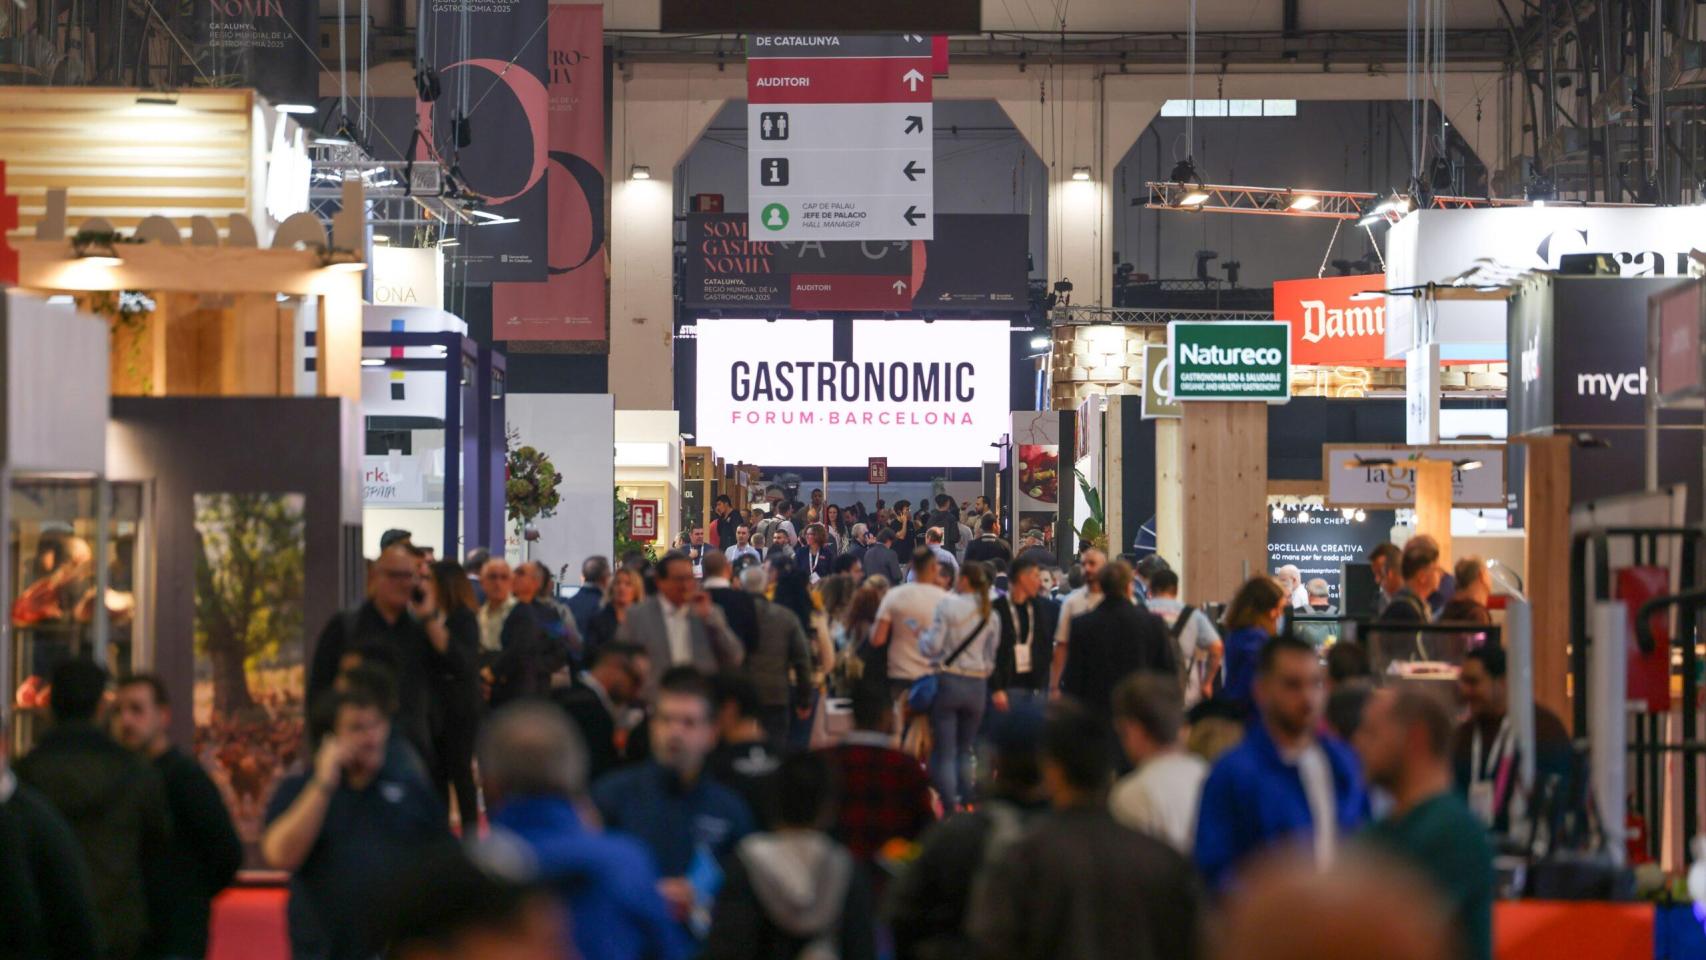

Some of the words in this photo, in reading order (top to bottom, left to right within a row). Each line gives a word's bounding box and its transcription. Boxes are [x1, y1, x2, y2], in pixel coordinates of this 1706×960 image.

[493, 5, 511, 13] 2025
[756, 36, 771, 46] DE
[773, 36, 840, 46] CATALUNYA
[756, 77, 810, 87] AUDITORI
[704, 257, 771, 273] NOMIA
[796, 284, 831, 292] AUDITORI
[1180, 343, 1282, 366] Natureco
[731, 361, 975, 402] GASTRONOMIC
[1180, 372, 1227, 382] GASTRONOMIA
[1228, 372, 1239, 382] BIO
[1246, 372, 1281, 382] SALUDABLE
[1180, 382, 1206, 391] ORGANIC
[1206, 382, 1217, 391] AND
[1218, 382, 1242, 391] HEALTHY
[1242, 382, 1281, 391] GASTRONOMY
[1321, 545, 1364, 553] CREATIVA
[1313, 553, 1322, 561] fer
[1323, 553, 1339, 561] cada
[1340, 553, 1353, 562] plat
